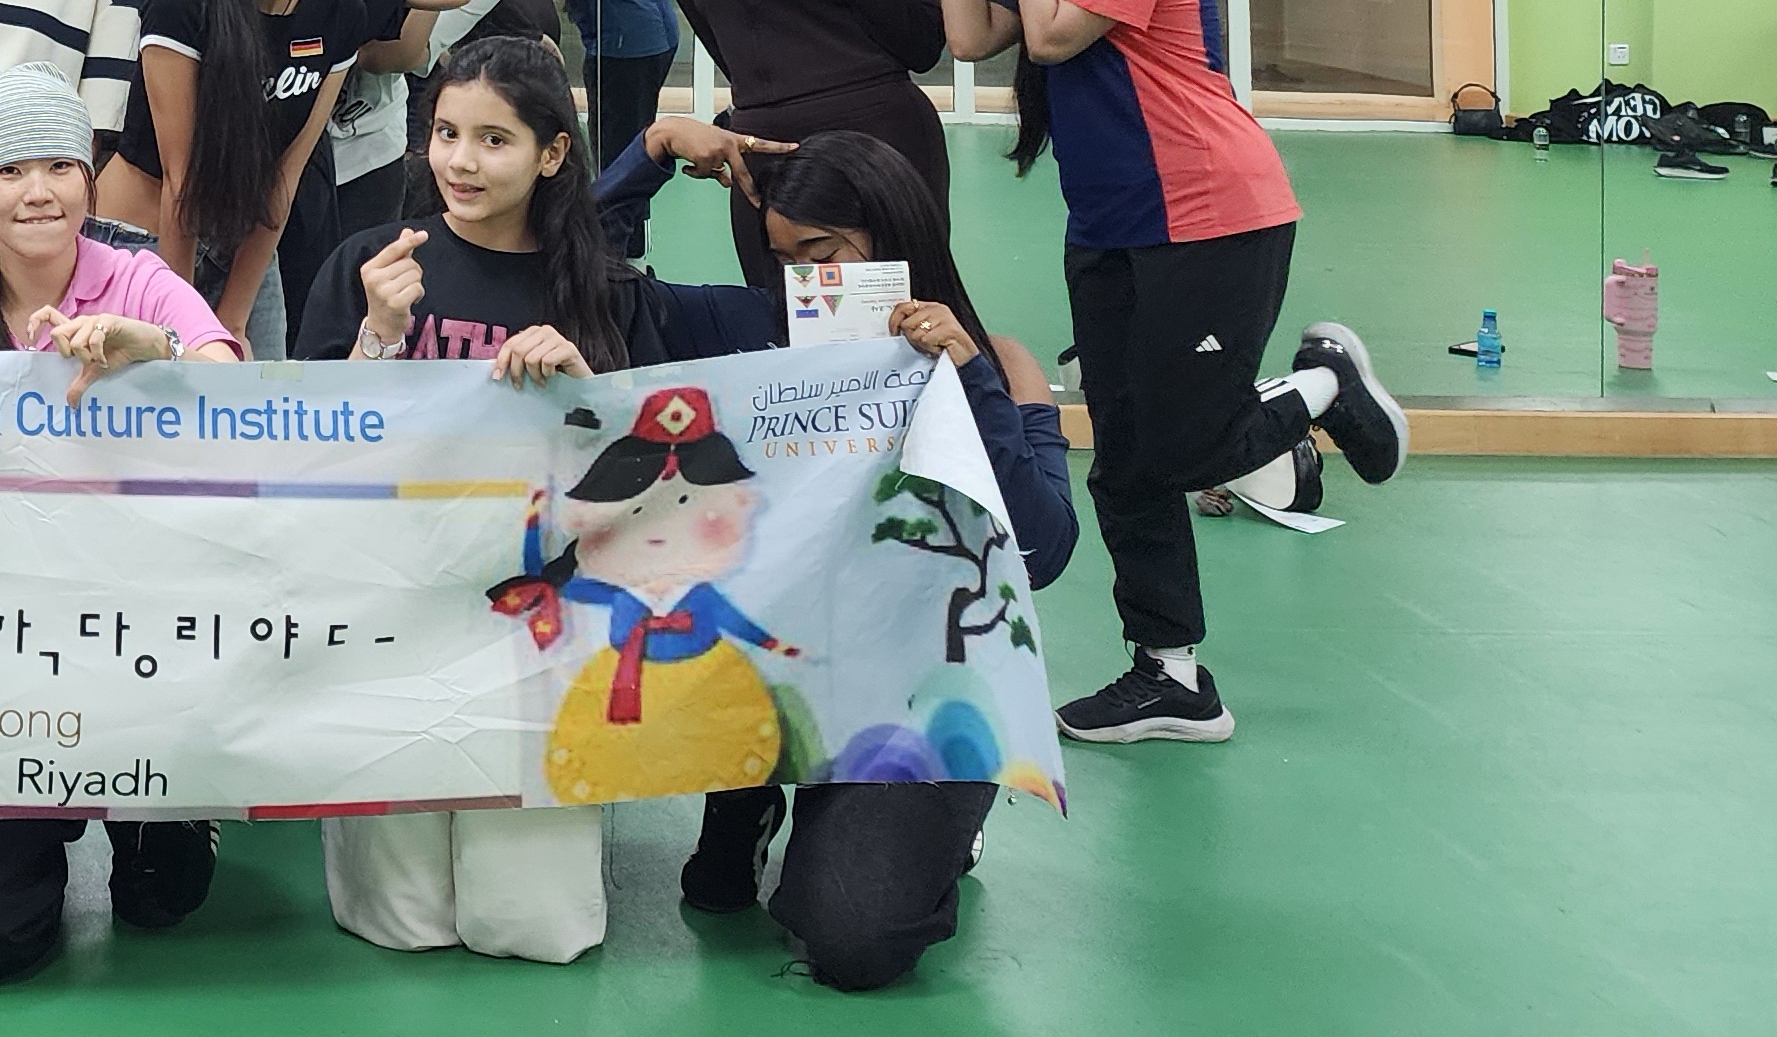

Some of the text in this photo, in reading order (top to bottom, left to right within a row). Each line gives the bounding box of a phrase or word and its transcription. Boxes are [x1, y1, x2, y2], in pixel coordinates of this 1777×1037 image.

[15, 390, 181, 439] Culture
[197, 394, 385, 443] Institute
[752, 379, 824, 411] سلطان
[747, 405, 849, 443] PRINCE
[17, 757, 169, 806] Riyadh
